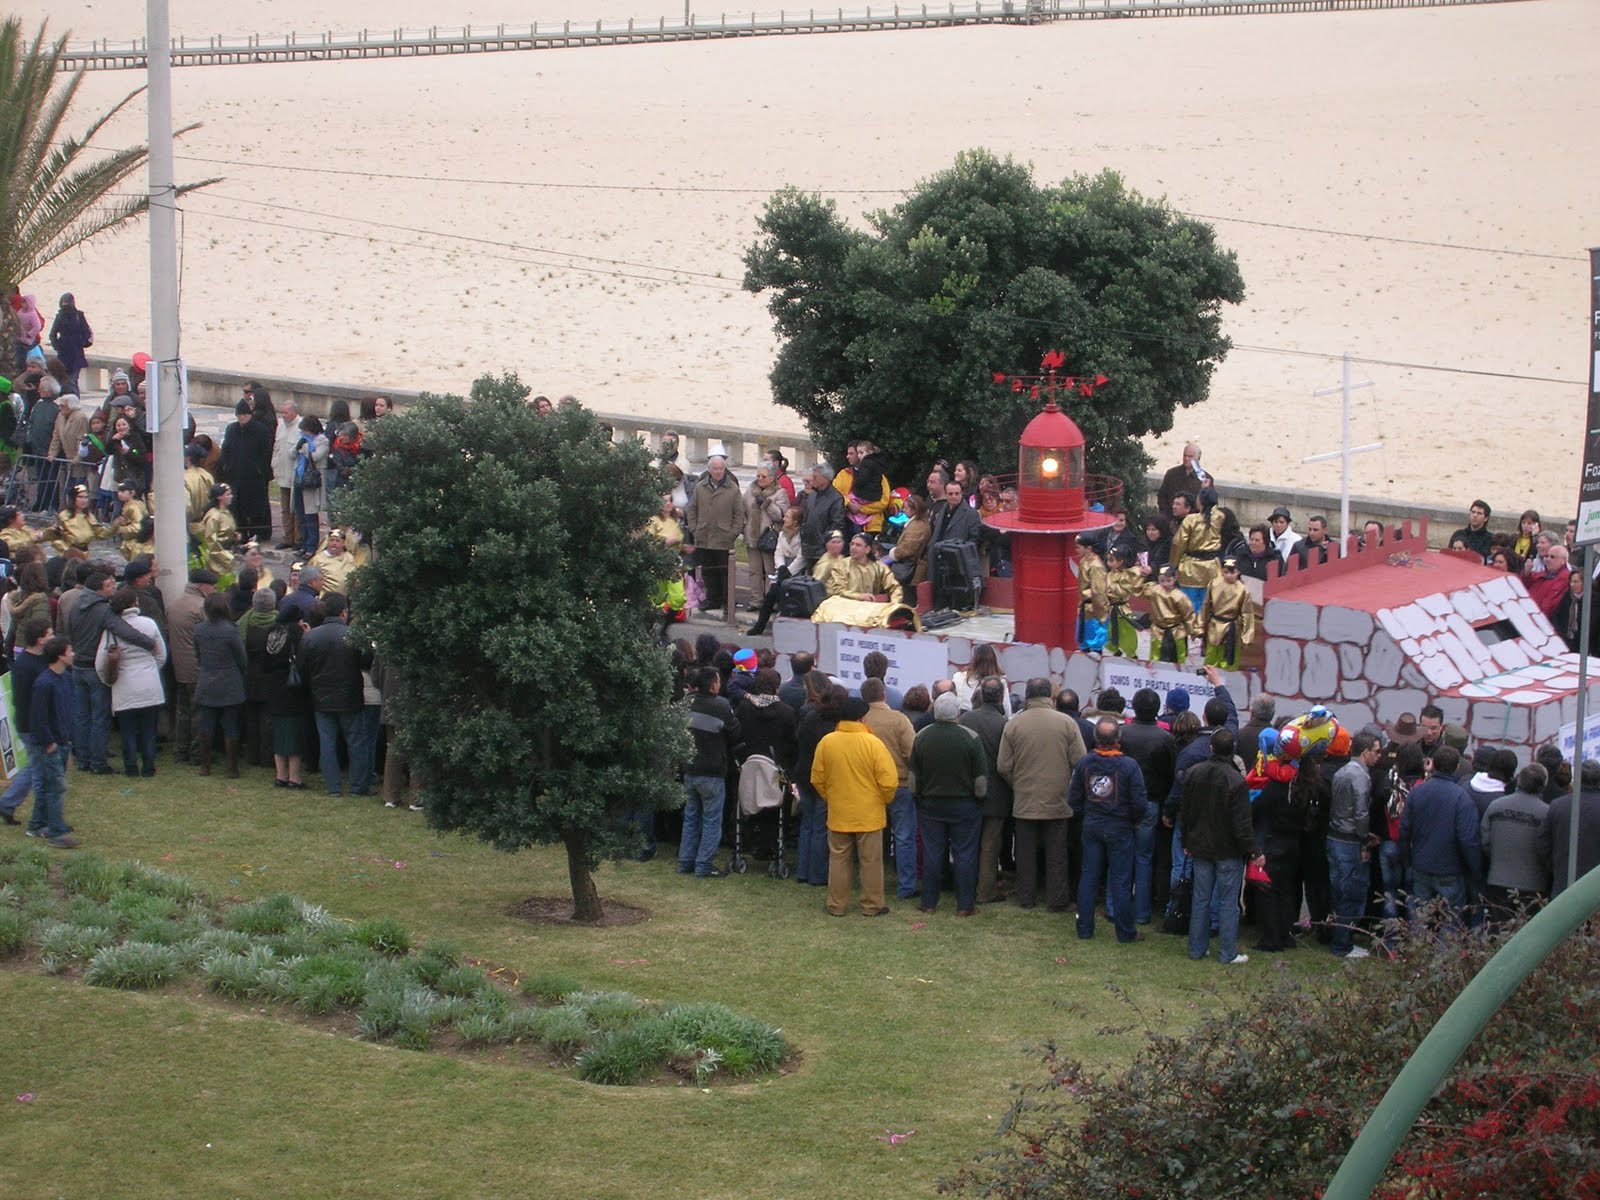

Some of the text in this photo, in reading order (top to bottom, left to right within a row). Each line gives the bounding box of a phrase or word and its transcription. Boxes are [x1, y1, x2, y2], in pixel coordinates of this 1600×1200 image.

[1110, 674, 1130, 686] SOMOS
[1133, 678, 1142, 689] OS
[1145, 680, 1170, 692] PIRATAS
